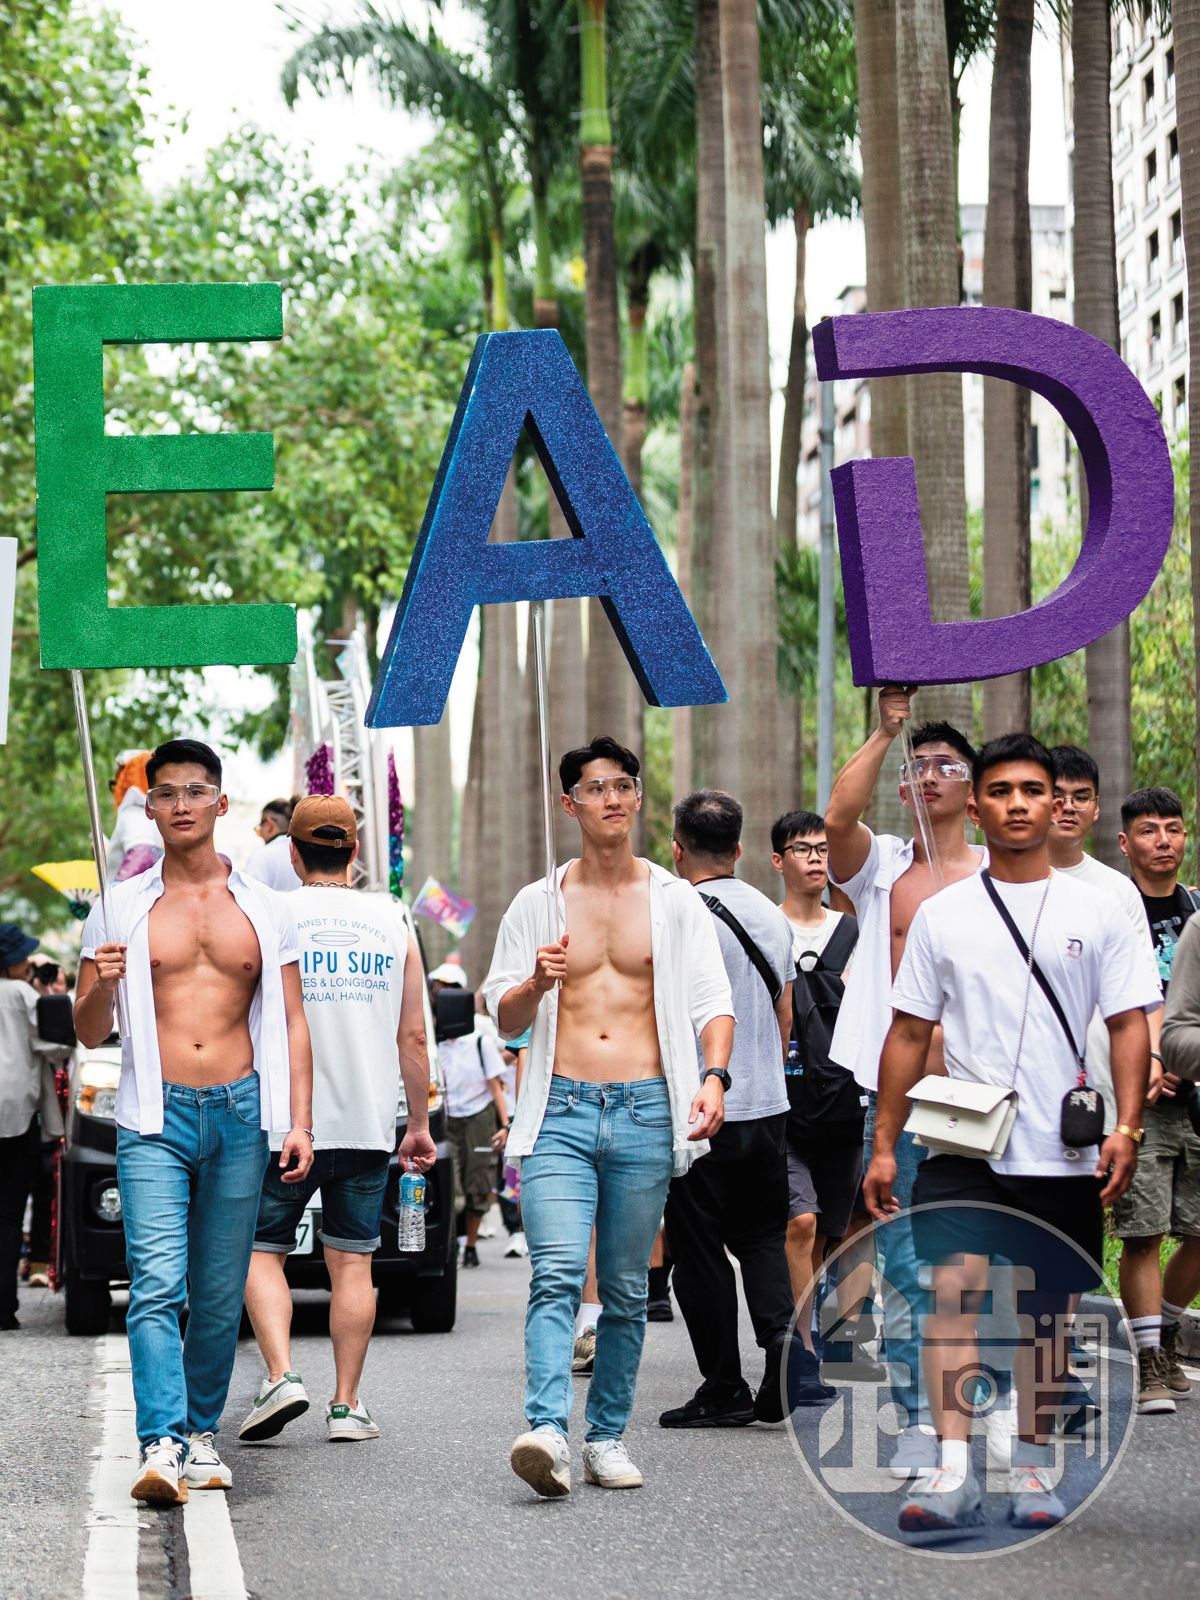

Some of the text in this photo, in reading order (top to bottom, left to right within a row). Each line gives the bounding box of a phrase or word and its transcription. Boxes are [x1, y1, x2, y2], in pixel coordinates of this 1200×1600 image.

[333, 918, 347, 927] TO
[351, 921, 386, 943] WAVES
[304, 951, 393, 976] IPU SURF
[301, 978, 317, 988] ES
[320, 978, 327, 988] &
[303, 992, 337, 1003] KAUAI,
